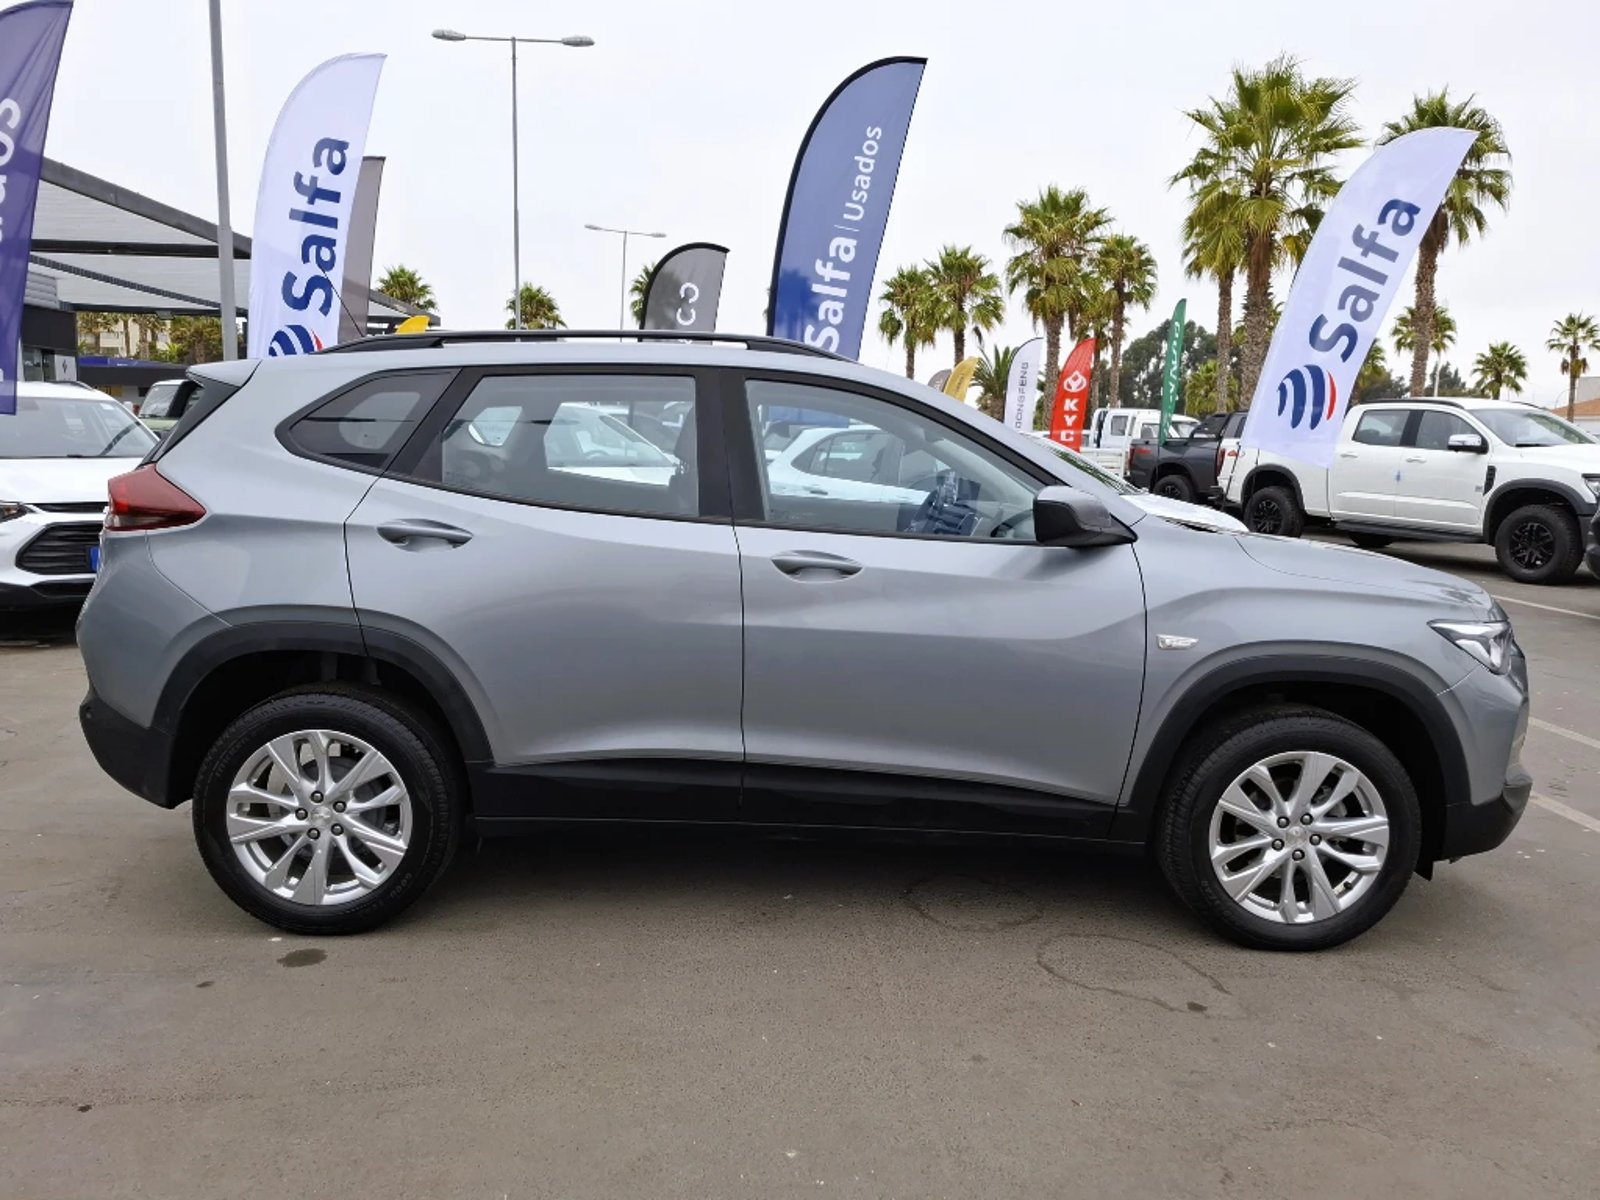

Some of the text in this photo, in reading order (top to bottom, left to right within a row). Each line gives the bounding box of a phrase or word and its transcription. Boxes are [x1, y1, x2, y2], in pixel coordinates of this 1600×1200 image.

[281, 136, 350, 317] Salfa
[804, 125, 882, 353] Salfa Usados
[1309, 198, 1421, 363] Salfa
[1015, 361, 1029, 429] DONGFENG
[1060, 398, 1079, 442] KYC
